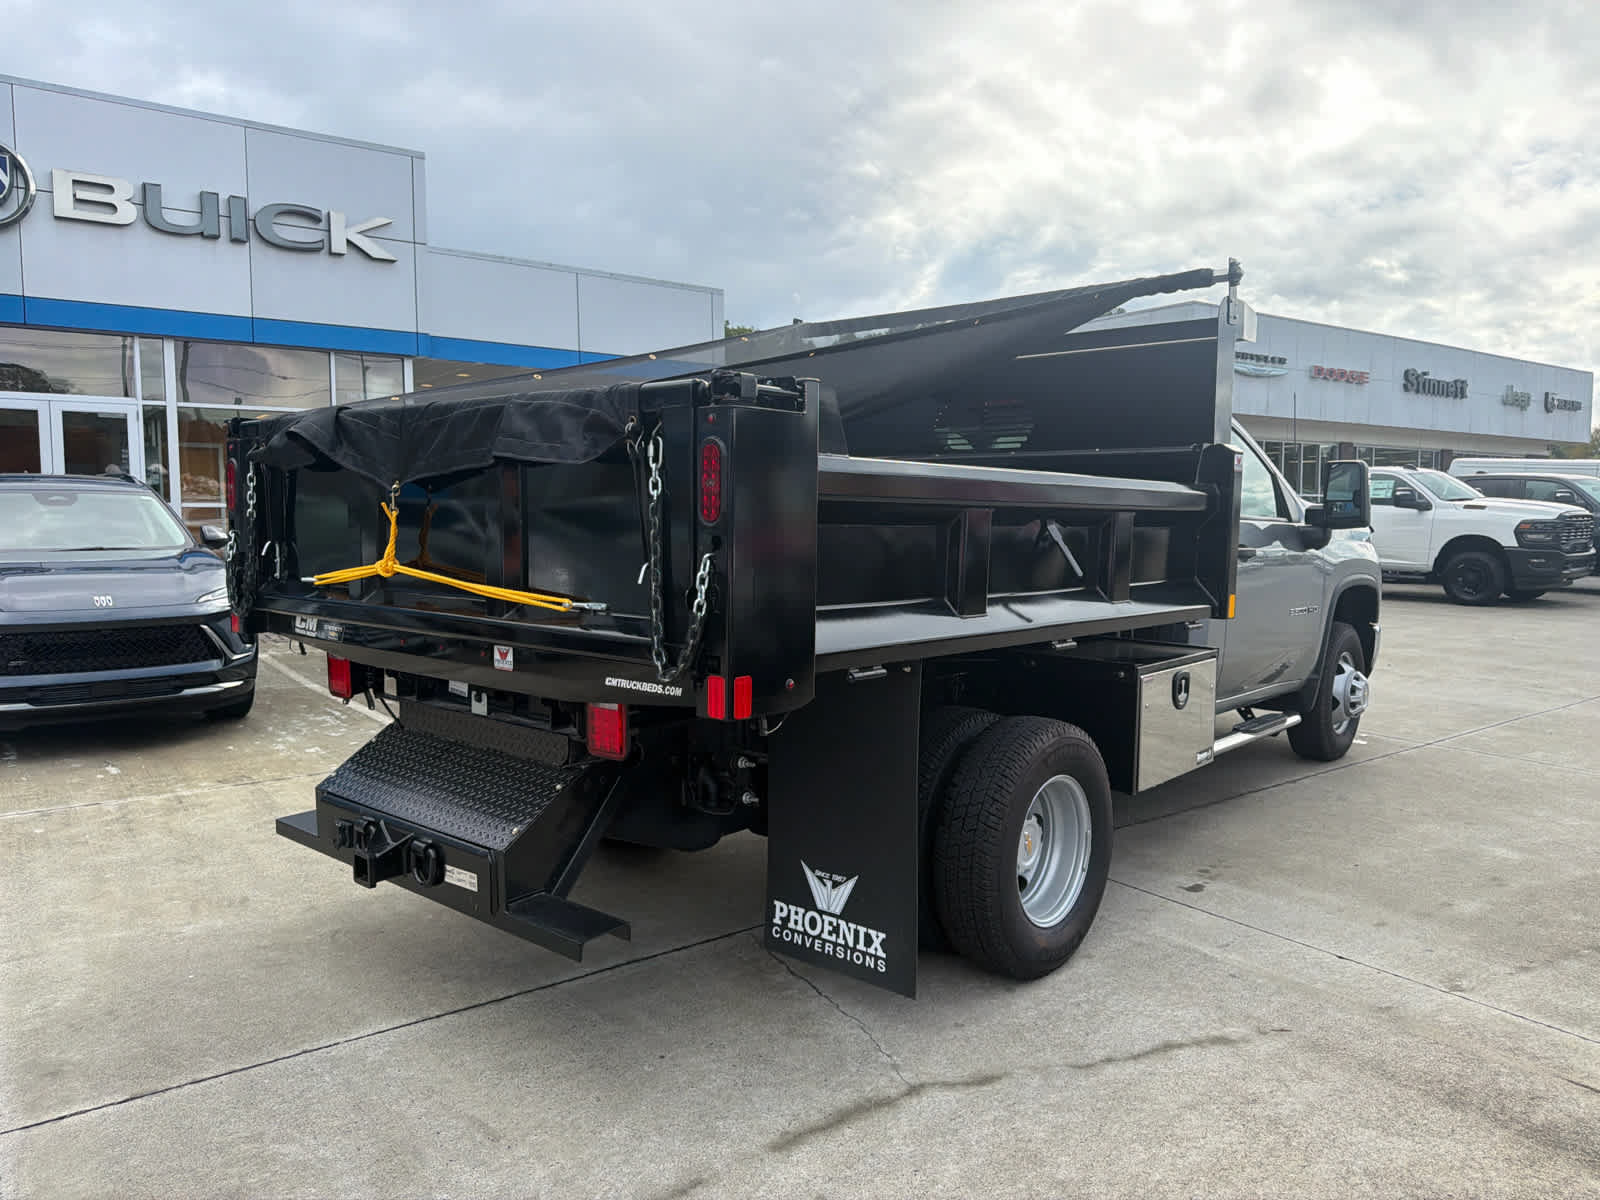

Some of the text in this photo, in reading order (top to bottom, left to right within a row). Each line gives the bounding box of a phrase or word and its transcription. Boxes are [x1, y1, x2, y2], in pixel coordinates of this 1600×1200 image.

[51, 168, 398, 264] BUICK
[1311, 365, 1370, 385] DODGE
[1403, 367, 1468, 400] Stinnett
[1503, 384, 1532, 411] Jeep
[605, 676, 683, 697] CMTRUCKBEDS.COM
[772, 900, 887, 959] PHOENIX
[772, 926, 887, 973] CONVERSIONS
